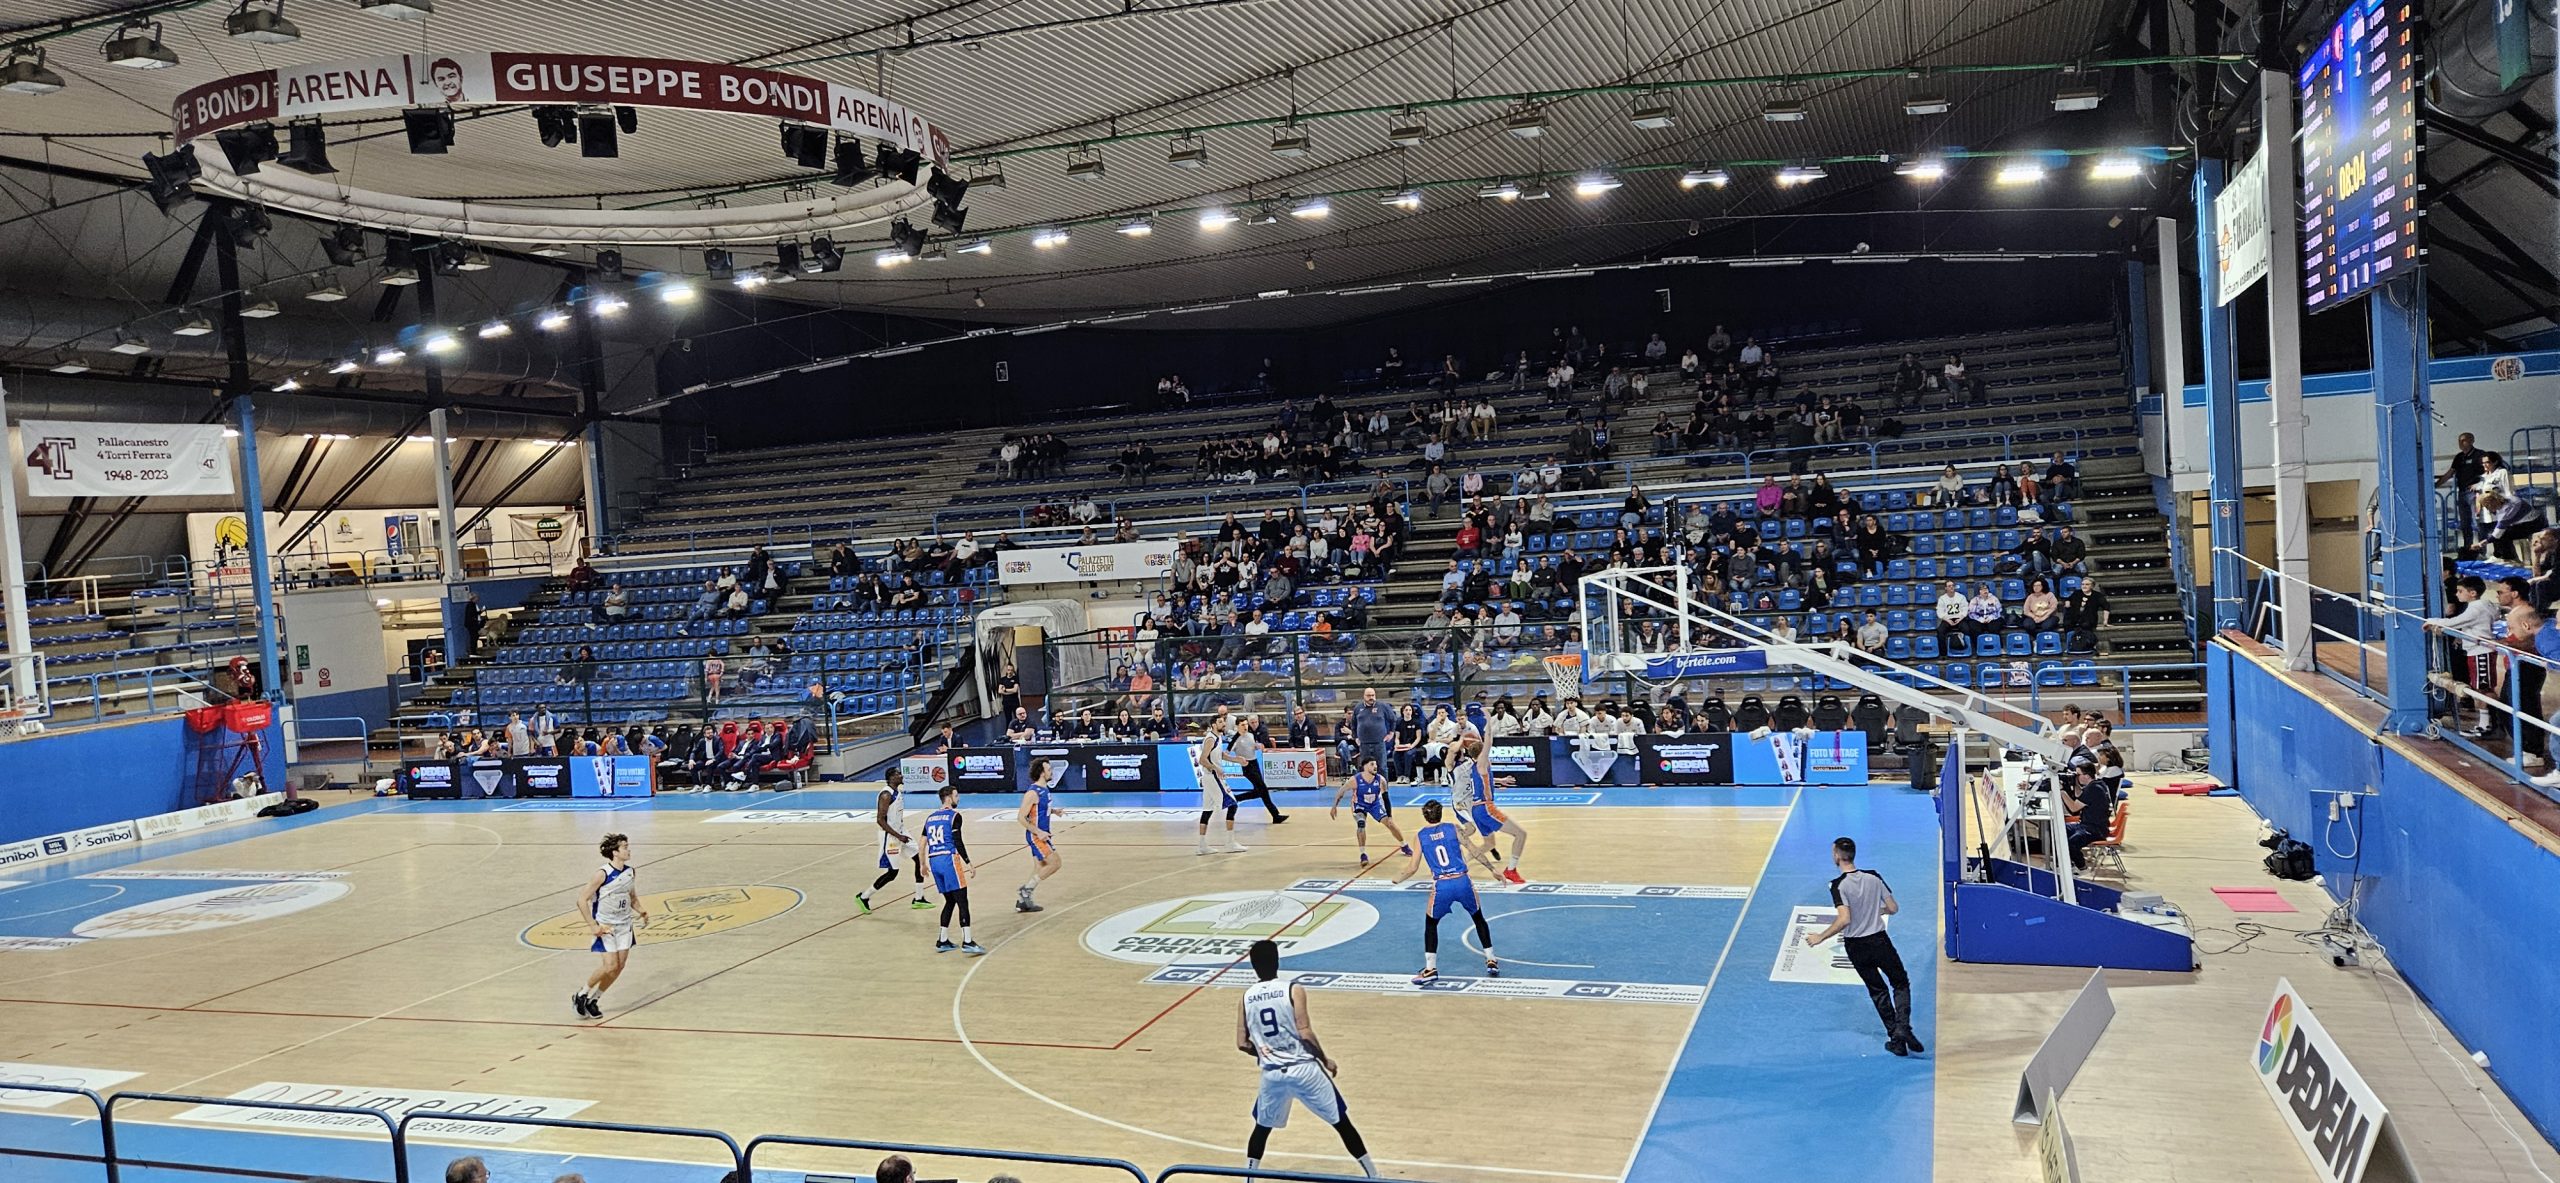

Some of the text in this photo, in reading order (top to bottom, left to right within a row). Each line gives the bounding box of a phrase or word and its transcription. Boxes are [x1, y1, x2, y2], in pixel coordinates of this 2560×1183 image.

[286, 67, 399, 106] ARENA
[505, 62, 823, 116] GIUSEPPE BONDI
[196, 82, 268, 125] BONDI
[837, 96, 903, 137] ARENA
[2339, 149, 2366, 201] 08:04
[97, 437, 169, 448] Pallacanestro
[97, 450, 172, 460] 4 Torri Ferrara
[1078, 555, 1114, 565] PALAZZETTO
[1078, 564, 1114, 573] DELLO SPORT
[1947, 603, 1960, 615] 23
[1676, 656, 1737, 669] bertele.com
[1489, 745, 1536, 758] DEDEM
[1810, 748, 1828, 758] FOTO
[965, 756, 1004, 767] DEDEM
[1672, 760, 1709, 769] DEDEM
[420, 766, 451, 777] DEDEM
[1110, 767, 1141, 777] DEDEM
[86, 829, 133, 847] Sanibol
[927, 824, 945, 846] 34
[1435, 845, 1450, 867] 0
[618, 899, 627, 909] 18
[1162, 969, 1200, 980] CFI
[1297, 974, 1337, 984] CFI
[1434, 981, 1468, 991] CFI
[1574, 986, 1612, 995] CFI
[1247, 990, 1285, 1004] SANTIAGO
[1260, 1007, 1280, 1037] 9
[2275, 1023, 2371, 1183] DEDEM
[251, 1113, 374, 1129] pianificare
[409, 1120, 506, 1138] esterna
